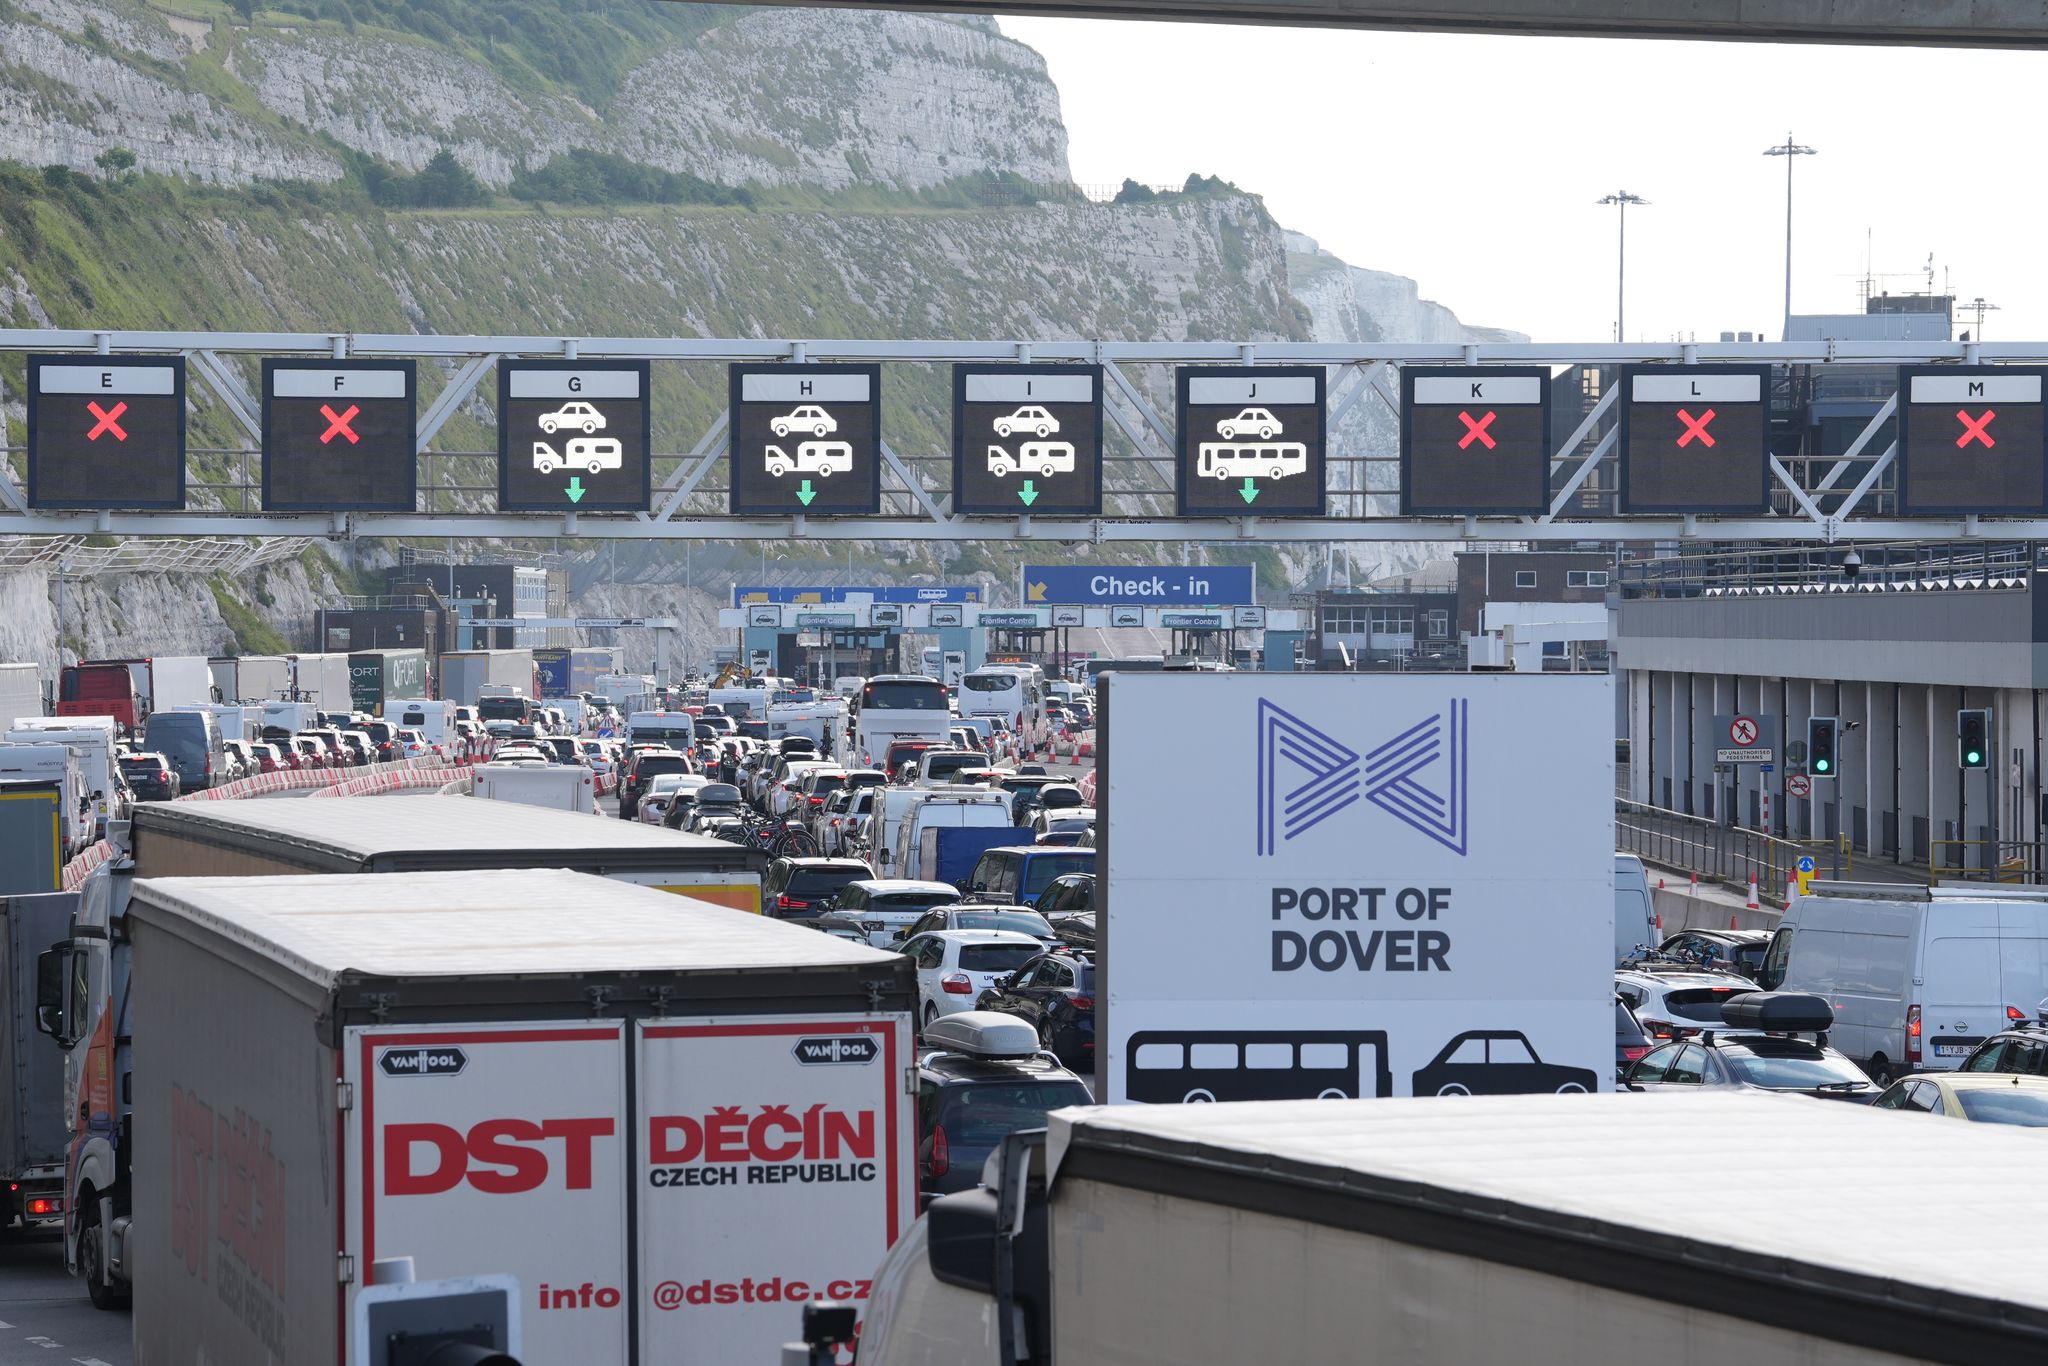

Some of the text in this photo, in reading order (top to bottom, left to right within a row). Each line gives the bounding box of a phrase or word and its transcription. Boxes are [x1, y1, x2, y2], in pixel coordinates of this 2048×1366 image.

[102, 373, 112, 387] E
[335, 377, 344, 390] F
[568, 377, 581, 392] G
[801, 381, 812, 395] H
[1249, 384, 1256, 398] J
[1472, 384, 1482, 397] K
[1692, 382, 1700, 395] L
[1969, 382, 1983, 396] M
[1091, 576, 1165, 595] Check
[1189, 576, 1209, 595] in
[1272, 888, 1451, 920] PORT OF
[1272, 930, 1451, 972] DOVER
[384, 1104, 875, 1195] DST DĚČÍN
[172, 1080, 213, 1285] DST
[650, 1163, 875, 1187] CZECH REPUBLIC
[540, 1277, 872, 1311] info @dstdc.cz
